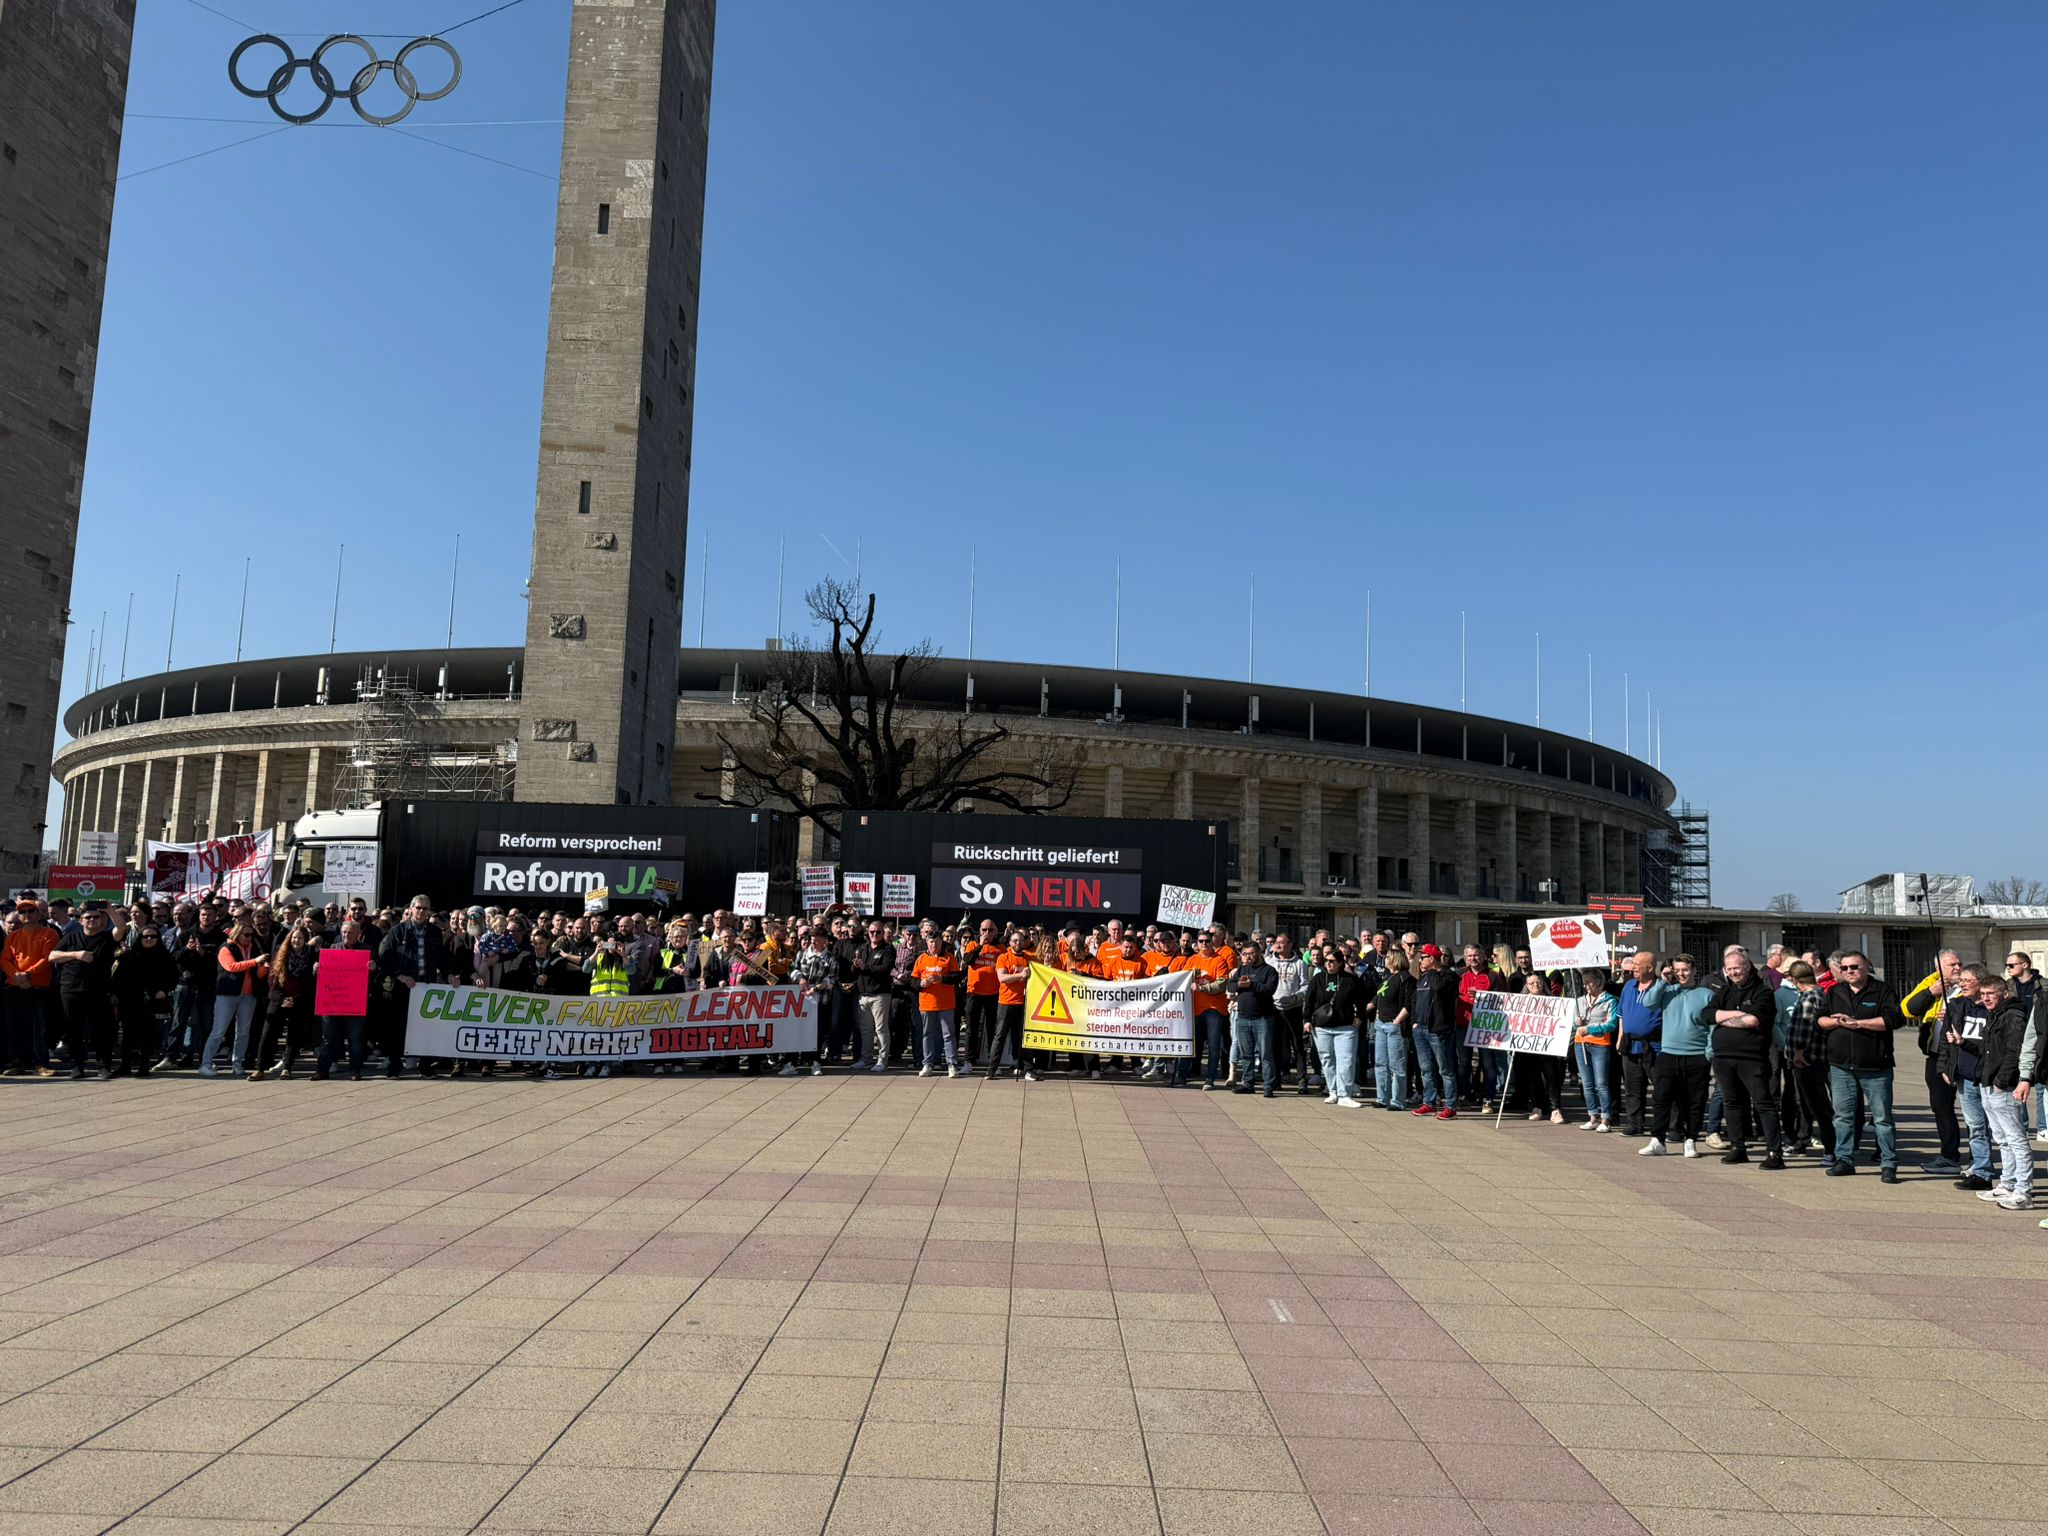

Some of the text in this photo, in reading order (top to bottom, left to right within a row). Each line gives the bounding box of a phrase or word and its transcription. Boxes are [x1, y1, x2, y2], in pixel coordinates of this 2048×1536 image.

[499, 833, 662, 853] Reform versprochen!
[954, 845, 1120, 865] Rückschritt geliefert!
[483, 861, 606, 893] Reform
[615, 866, 658, 895] JA
[806, 866, 830, 874] QUALITÄT
[848, 881, 871, 893] NEIN!
[959, 875, 1112, 909] So NEIN.
[738, 900, 762, 910] NEIN
[1162, 897, 1183, 911] DARF
[1189, 890, 1214, 905] ZERO
[1606, 944, 1638, 953] Rsiko?
[1071, 985, 1185, 1002] Führerscheinreform
[419, 989, 807, 1028] CLEVER. FAHREN. LERNEN.
[1087, 1006, 1185, 1020] wenn Regeln sterben,
[1086, 1022, 1169, 1036] sterben Menschen
[1471, 1011, 1508, 1032] WERDEN
[456, 1023, 773, 1057] GEHT NICHT DIGITAL!
[1025, 1034, 1189, 1052] Fahrlehrerschaft Münster
[1467, 1029, 1556, 1053] LEBEN KOSTEN
